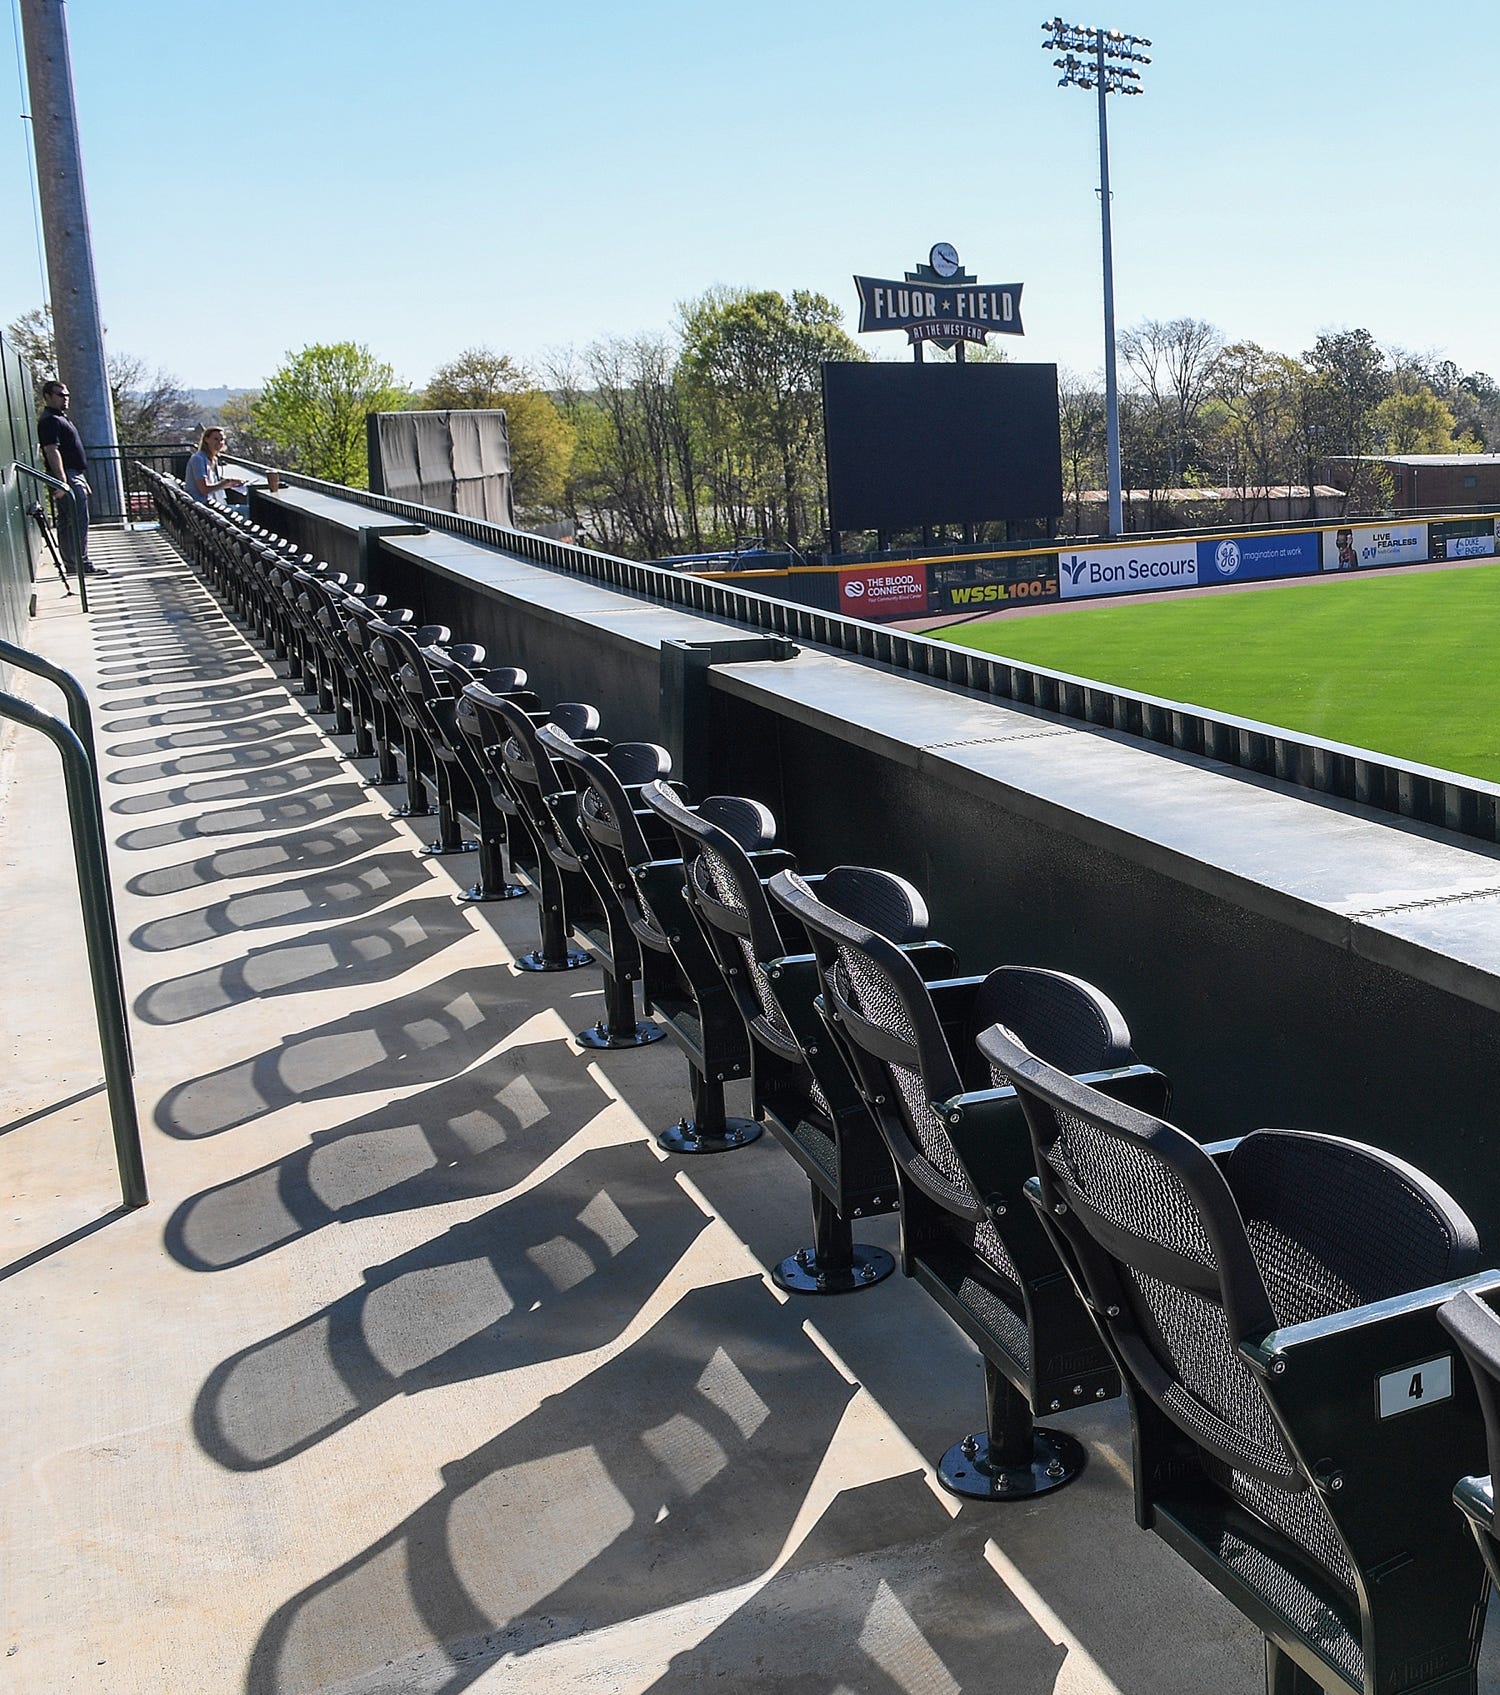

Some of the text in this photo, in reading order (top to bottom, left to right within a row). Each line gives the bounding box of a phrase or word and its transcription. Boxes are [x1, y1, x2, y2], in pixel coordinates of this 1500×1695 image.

[873, 287, 1013, 321] FLUOR FIELD
[913, 324, 982, 340] AT THE WEST END
[1372, 532, 1391, 541] LIVE
[1377, 537, 1418, 548] FEARLESS
[1465, 537, 1480, 547] DUKE
[1242, 546, 1302, 561] imagination at work
[1465, 546, 1486, 555] ENERGY
[1090, 559, 1196, 583] Bon Secours
[867, 575, 914, 587] THE BLOOD
[867, 584, 922, 597] CONNECTION
[1408, 1371, 1424, 1400] 4
